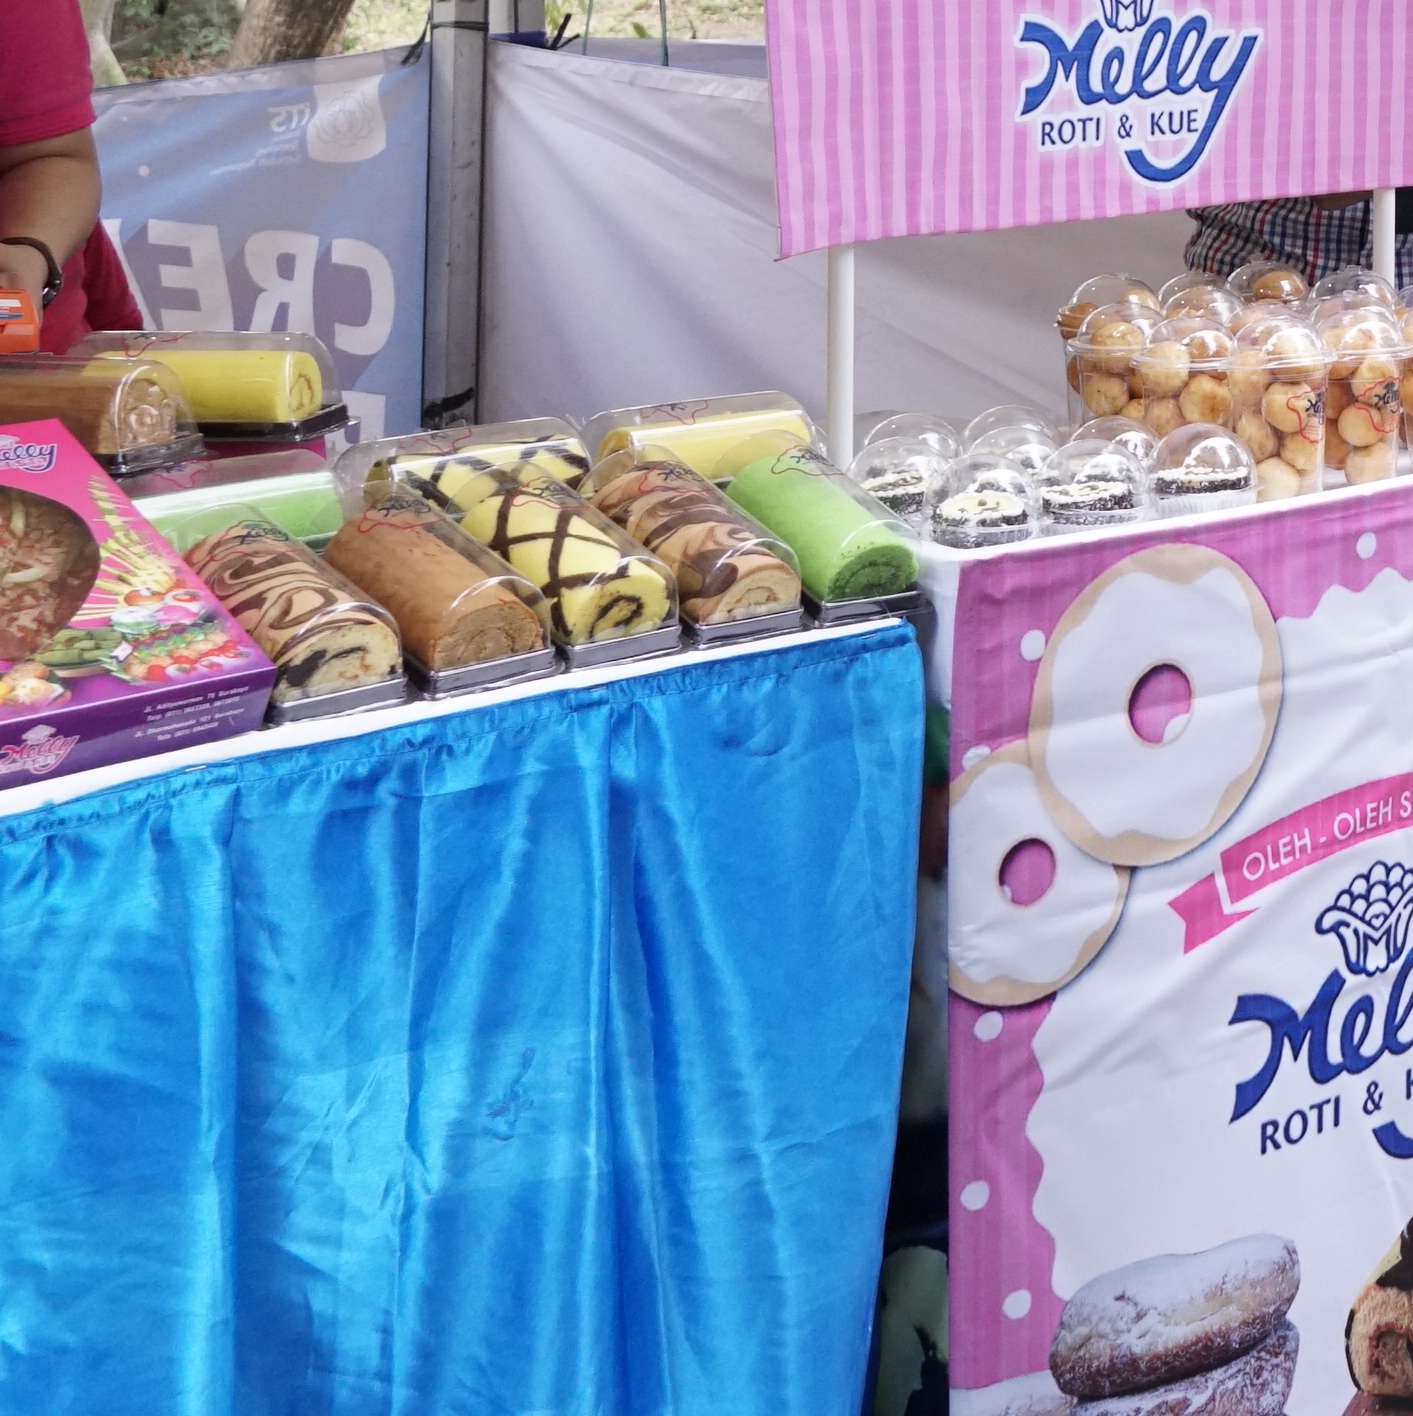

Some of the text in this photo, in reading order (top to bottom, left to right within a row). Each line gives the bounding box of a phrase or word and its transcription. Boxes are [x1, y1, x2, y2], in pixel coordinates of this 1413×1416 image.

[1020, 16, 1258, 183] Melly
[1041, 110, 1199, 146] ROTI & KUE
[0, 444, 56, 472] elly
[1243, 834, 1313, 883] OLEH
[1334, 797, 1393, 843] OLEH
[1261, 1096, 1344, 1156] ROTI
[1362, 1084, 1385, 1116] &
